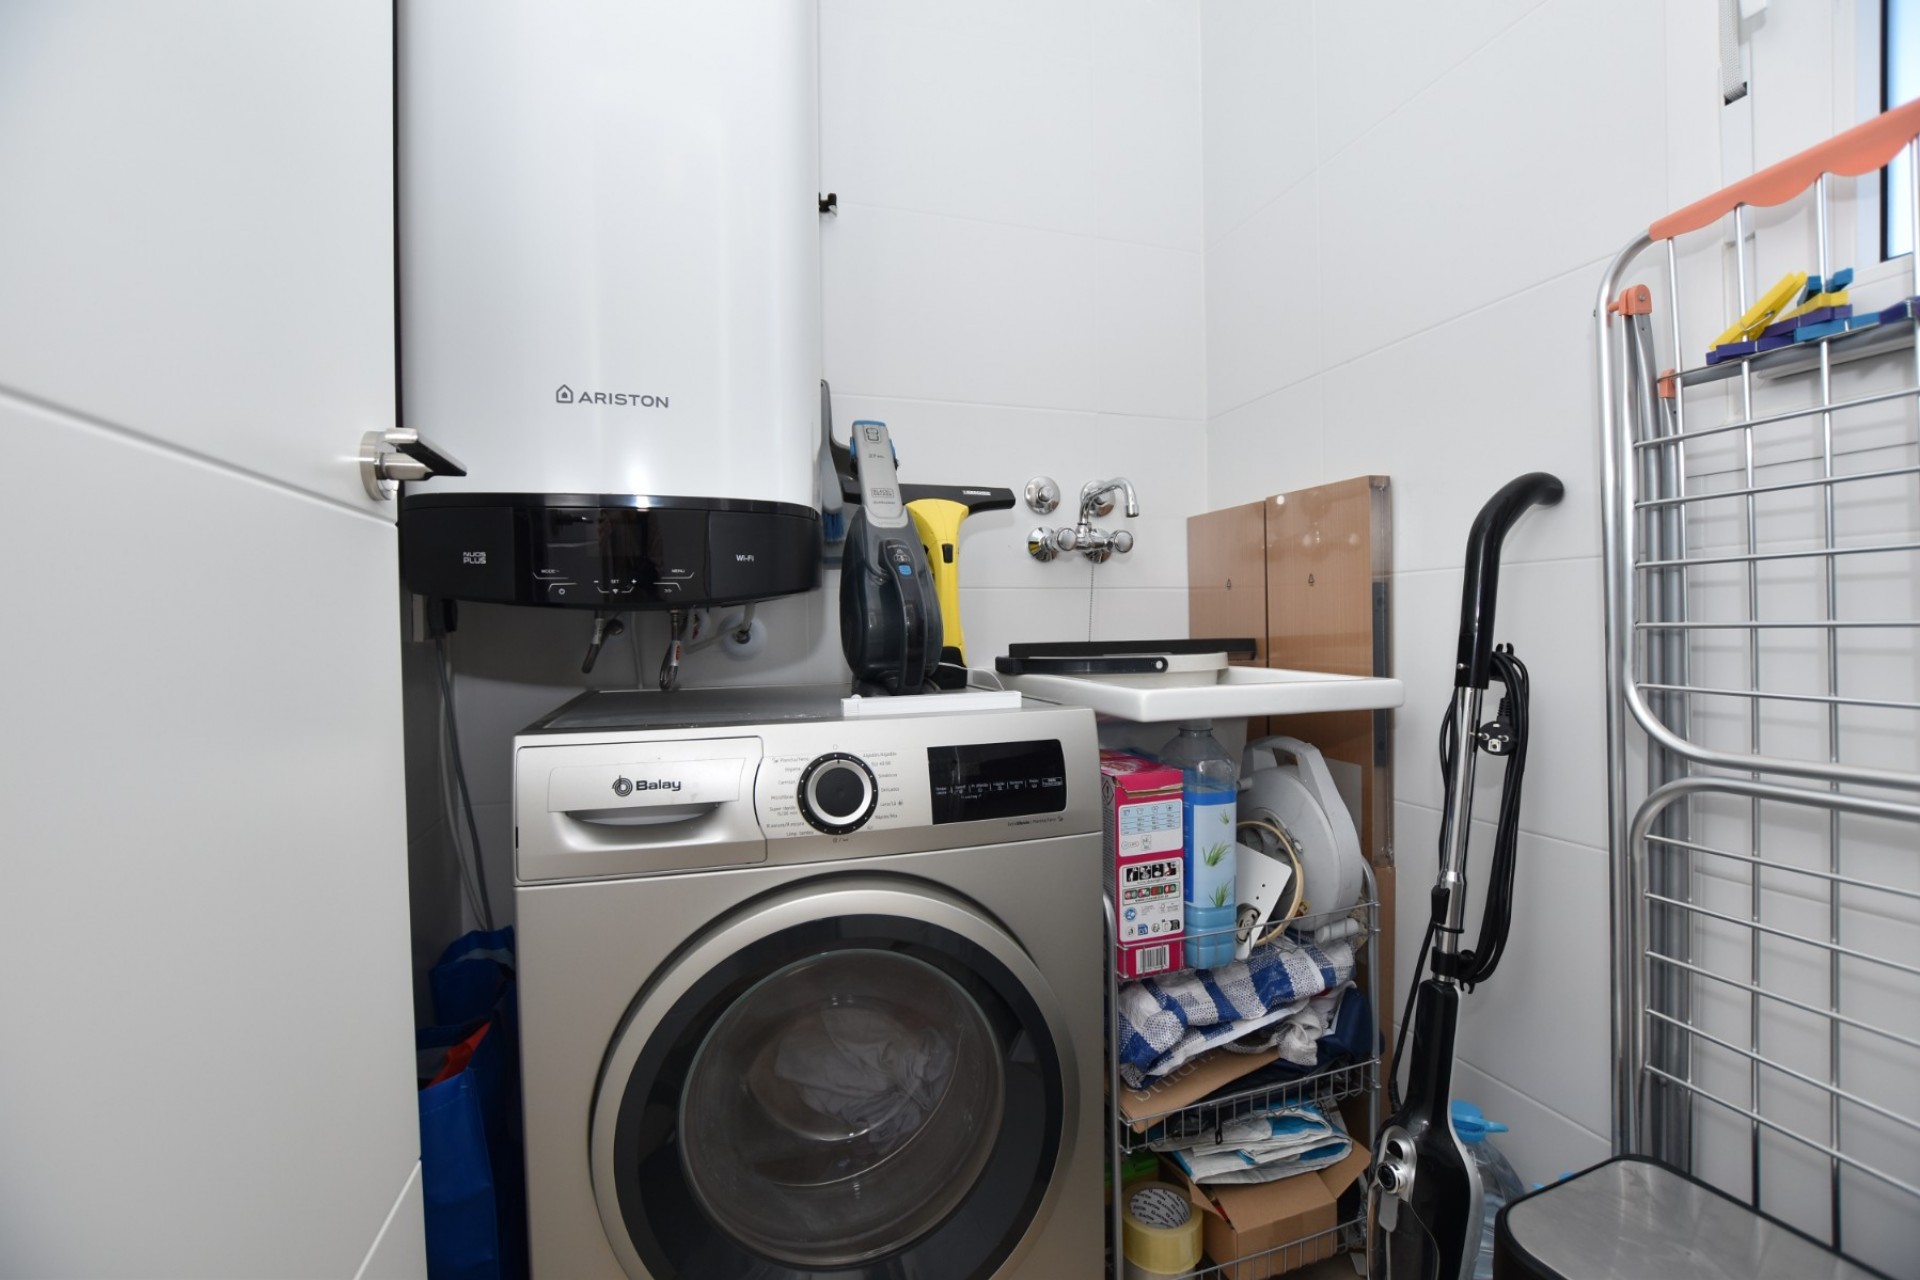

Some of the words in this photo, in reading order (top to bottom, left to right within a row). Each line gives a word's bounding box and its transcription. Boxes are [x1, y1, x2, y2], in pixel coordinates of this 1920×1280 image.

[578, 391, 669, 409] ARISTON
[463, 556, 486, 564] PLUS
[636, 779, 681, 791] Balay
